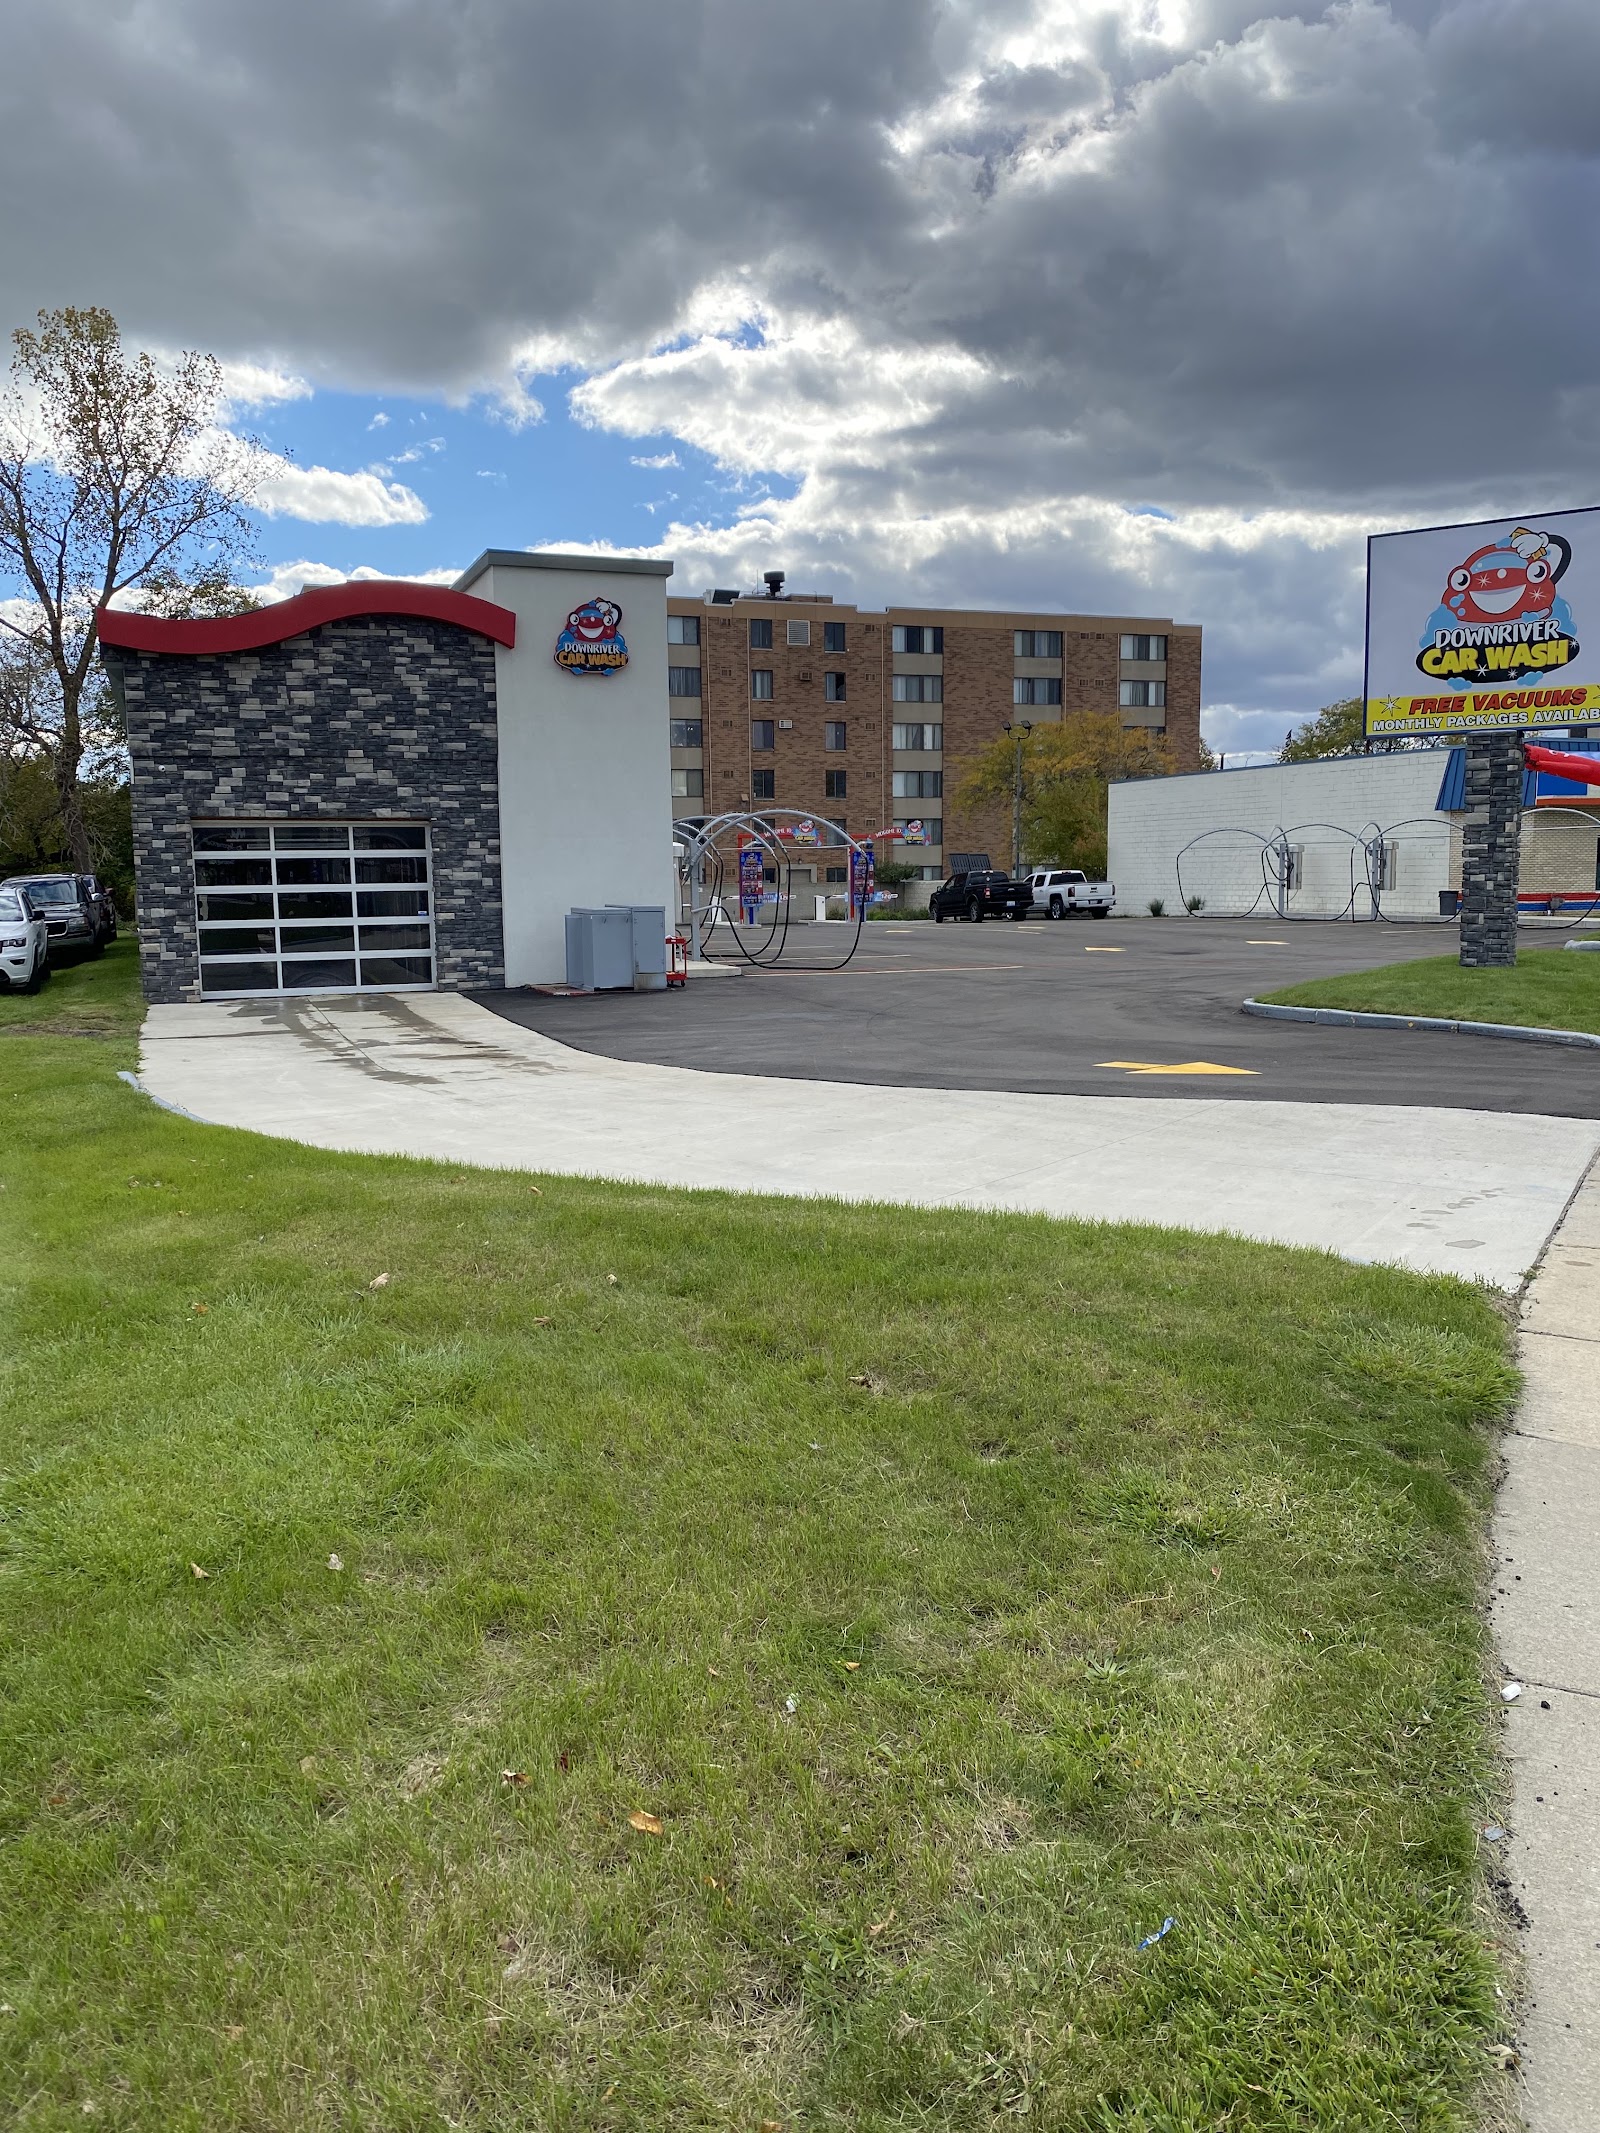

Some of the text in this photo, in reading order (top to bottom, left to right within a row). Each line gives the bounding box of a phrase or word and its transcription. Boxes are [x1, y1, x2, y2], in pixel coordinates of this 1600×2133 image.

[1435, 620, 1560, 648] DOWNRIVER
[559, 651, 626, 666] CAR WASH
[564, 643, 620, 654] DOWNRIVER
[1422, 639, 1569, 674] CAR WASH
[1409, 688, 1587, 715] FREE VACUUMS
[1373, 717, 1443, 731] MONTHLY
[1447, 712, 1528, 727] PACKAGES
